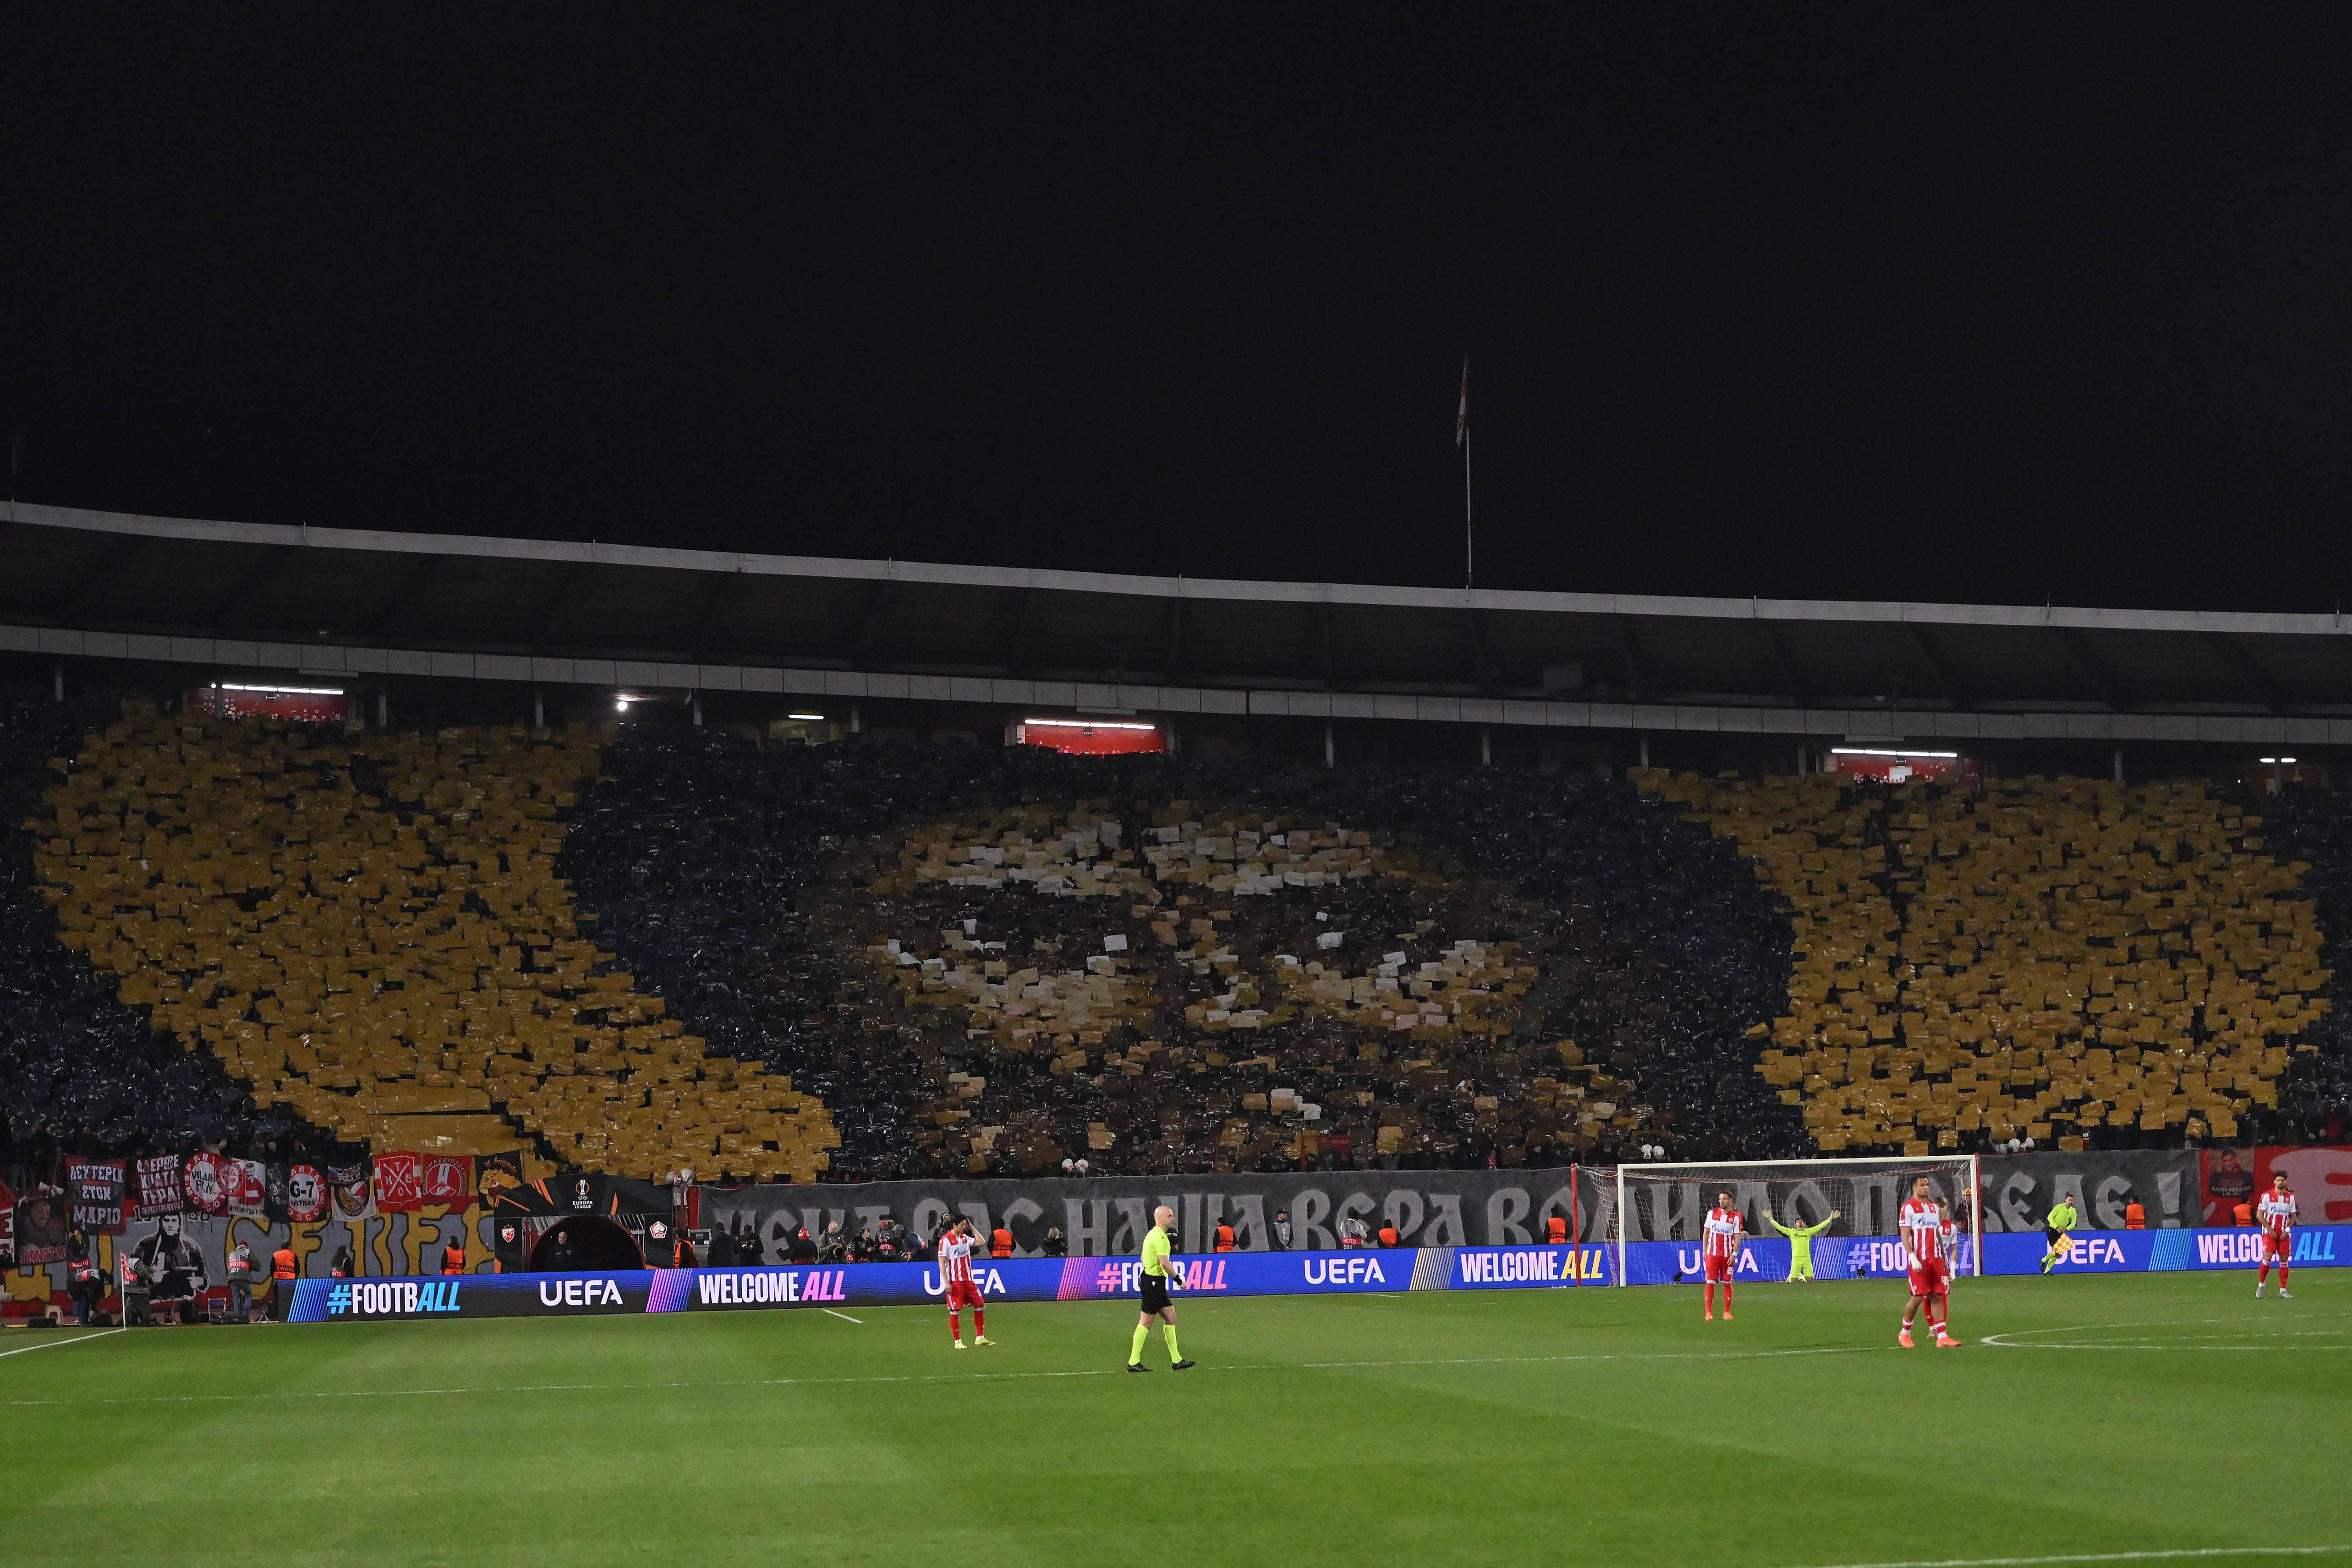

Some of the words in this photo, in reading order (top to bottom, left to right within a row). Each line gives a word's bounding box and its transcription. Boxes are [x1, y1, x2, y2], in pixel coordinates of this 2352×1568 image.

[290, 1181, 314, 1198] G-7
[2294, 1231, 2336, 1261] ALL
[1304, 1258, 1386, 1284] UEFA
[1460, 1251, 1558, 1283] WELCOME
[1561, 1250, 1603, 1279] ALL
[539, 1279, 623, 1306] UEFA
[699, 1272, 799, 1304] WELCOME
[802, 1271, 845, 1301] ALL
[924, 1268, 1006, 1295] UFA
[327, 1282, 461, 1314] #FOOTBALL
